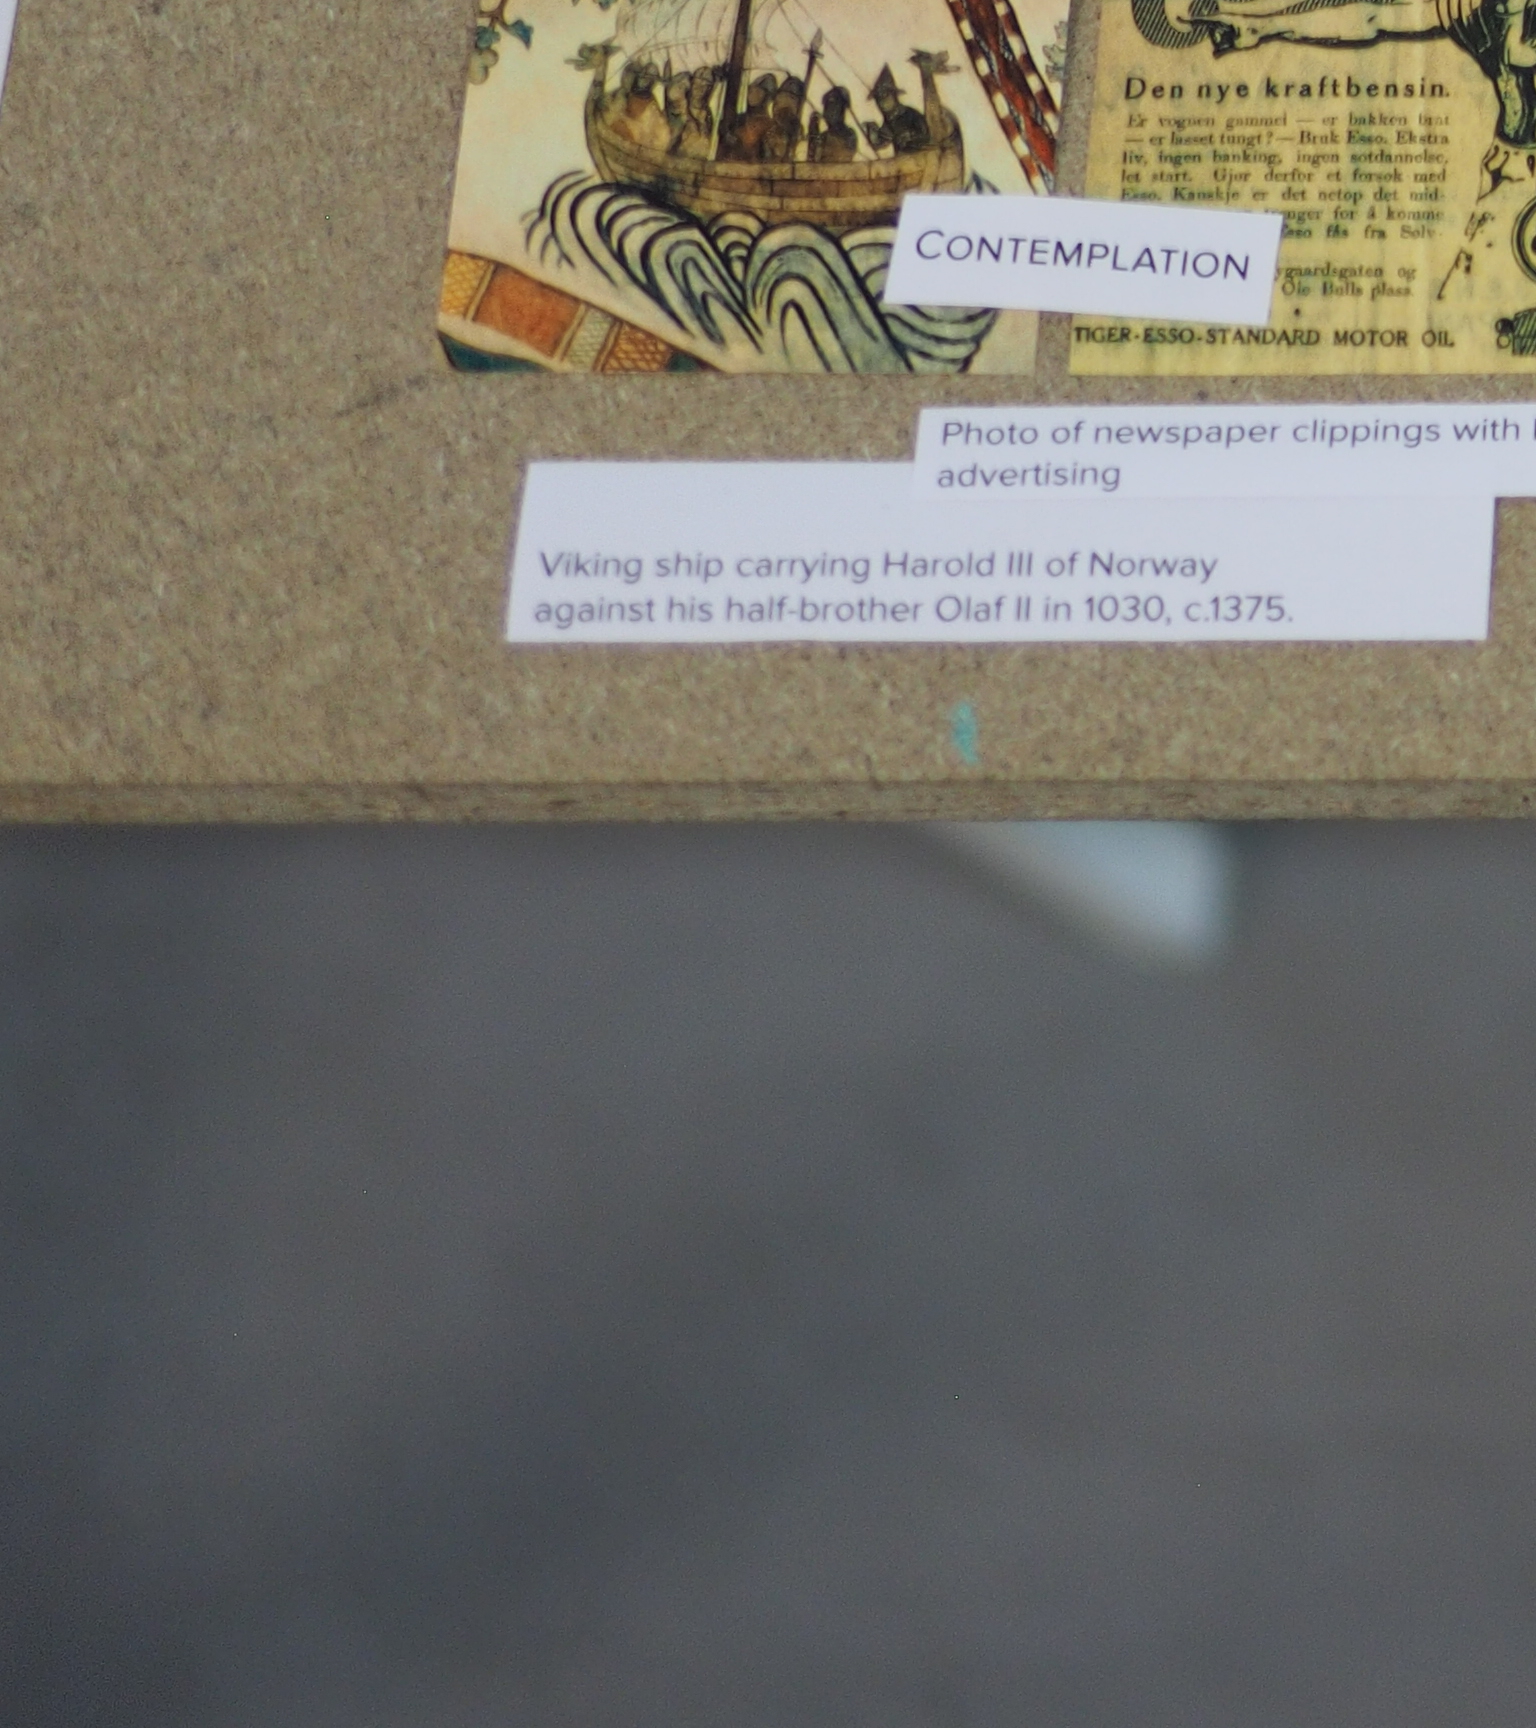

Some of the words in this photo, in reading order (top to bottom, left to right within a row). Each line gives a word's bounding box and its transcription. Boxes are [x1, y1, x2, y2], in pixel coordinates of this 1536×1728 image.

[1124, 75, 1185, 102] Den
[1196, 82, 1250, 105] nye
[1264, 74, 1451, 99] kraftbensin.
[1300, 130, 1339, 145] Bruk
[1395, 131, 1449, 145] Ekstra
[915, 228, 1250, 281] CONTEMPLATION
[1332, 326, 1409, 349] MOTOR
[1421, 326, 1455, 349] OIL
[941, 420, 1040, 447] Photo
[1050, 419, 1086, 445] of
[1093, 424, 1281, 450] newspaper
[1291, 418, 1441, 450] clippings
[1452, 417, 1521, 442] with
[936, 461, 1122, 494] advertising
[538, 550, 643, 586] Viking
[655, 551, 724, 584] ship
[735, 552, 871, 585] carrying
[882, 550, 996, 578] Harold
[1007, 551, 1034, 577] III
[1044, 550, 1081, 578] of
[1088, 550, 1219, 584] Norway
[533, 596, 656, 629] against
[666, 595, 714, 623] his
[724, 595, 924, 624] half-brother
[933, 593, 1007, 624] Olaf
[1014, 595, 1032, 623] II
[1043, 595, 1073, 622] in
[1084, 593, 1172, 626] 1030,
[1183, 594, 1294, 623] c.1375.
